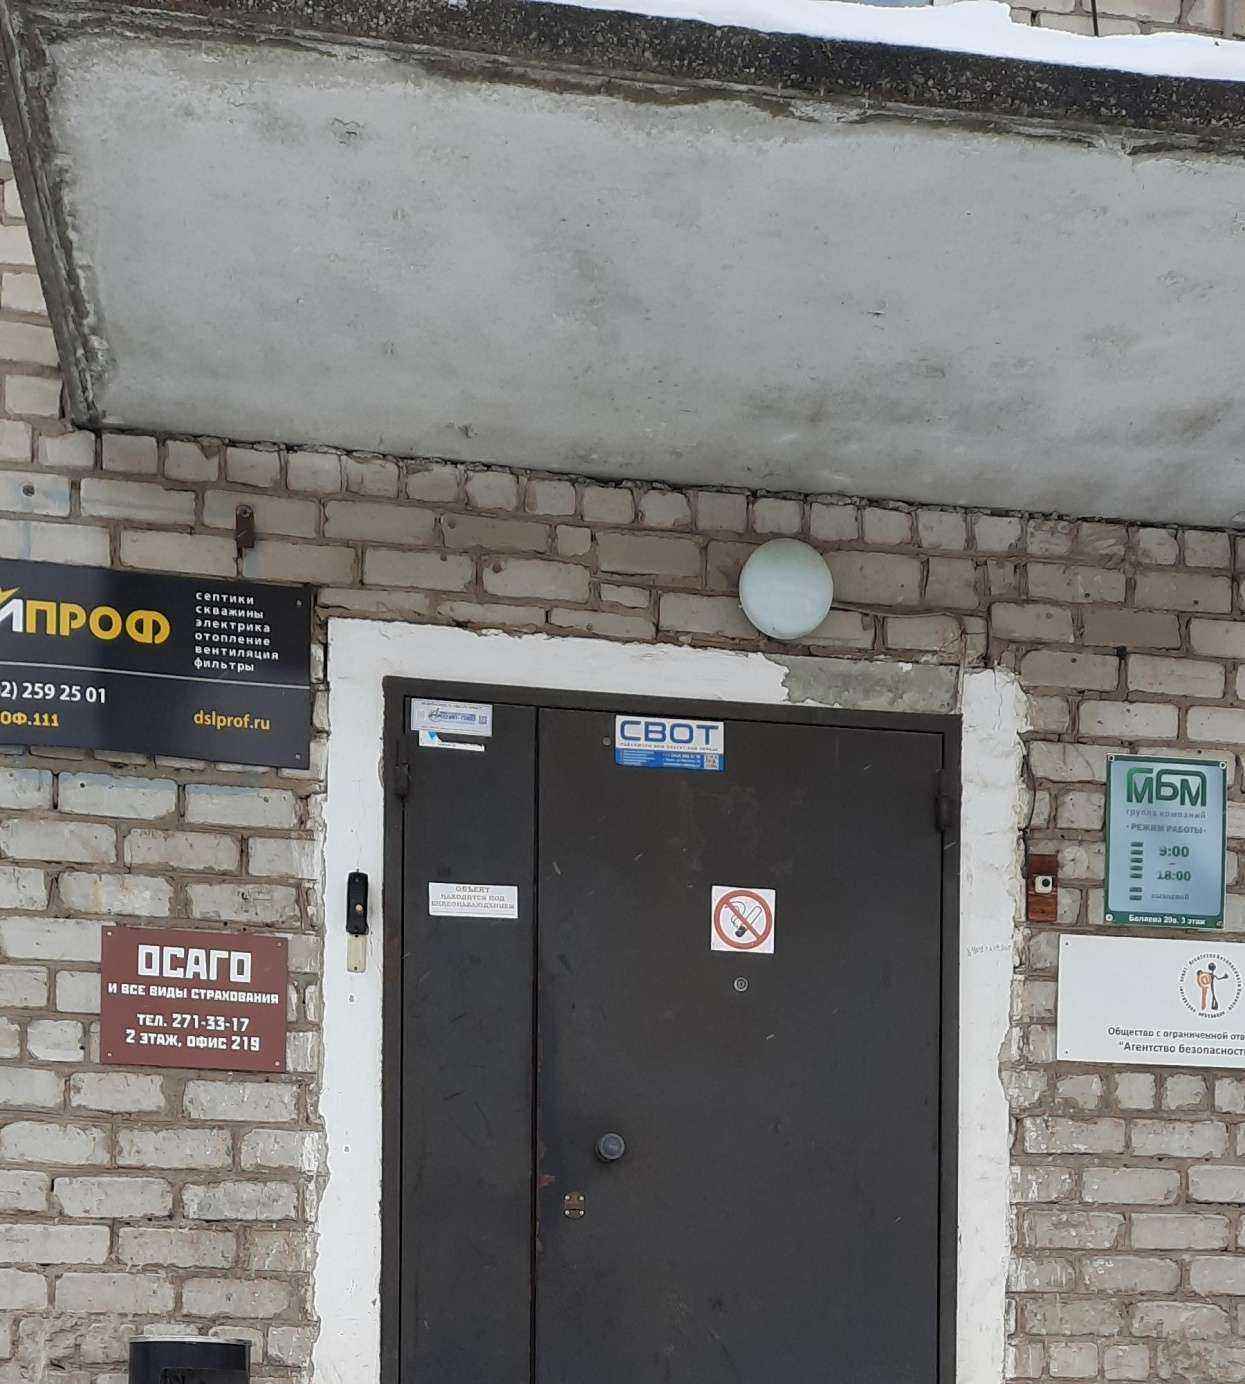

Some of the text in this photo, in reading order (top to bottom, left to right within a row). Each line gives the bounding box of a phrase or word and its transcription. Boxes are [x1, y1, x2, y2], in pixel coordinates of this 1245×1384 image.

[195, 591, 254, 605] септики
[195, 605, 264, 619] скважины
[195, 618, 271, 633] электрика
[194, 632, 271, 646] отопление
[194, 645, 279, 661] вентиляция
[193, 657, 255, 673] фильтры
[22, 682, 56, 700] 259
[60, 684, 81, 701] 25
[85, 686, 106, 704] 01
[193, 709, 270, 730] dslprof.ru
[620, 719, 719, 746] СВОТ
[1126, 767, 1208, 807] МБМ
[1159, 845, 1190, 858] 9:00
[1156, 870, 1192, 882] 18:00
[137, 944, 252, 983] ОСАГО
[108, 982, 279, 1005] И ВСЕ ВИДЫ СТРАХОВАНИЯ
[136, 1013, 250, 1032] ТЕЛ. 271-33-17
[125, 1029, 261, 1052] 2 ЭТАЖ, ОФИС 219
[1107, 1026, 1154, 1038] Общество
[1163, 1030, 1229, 1041] ограниченной
